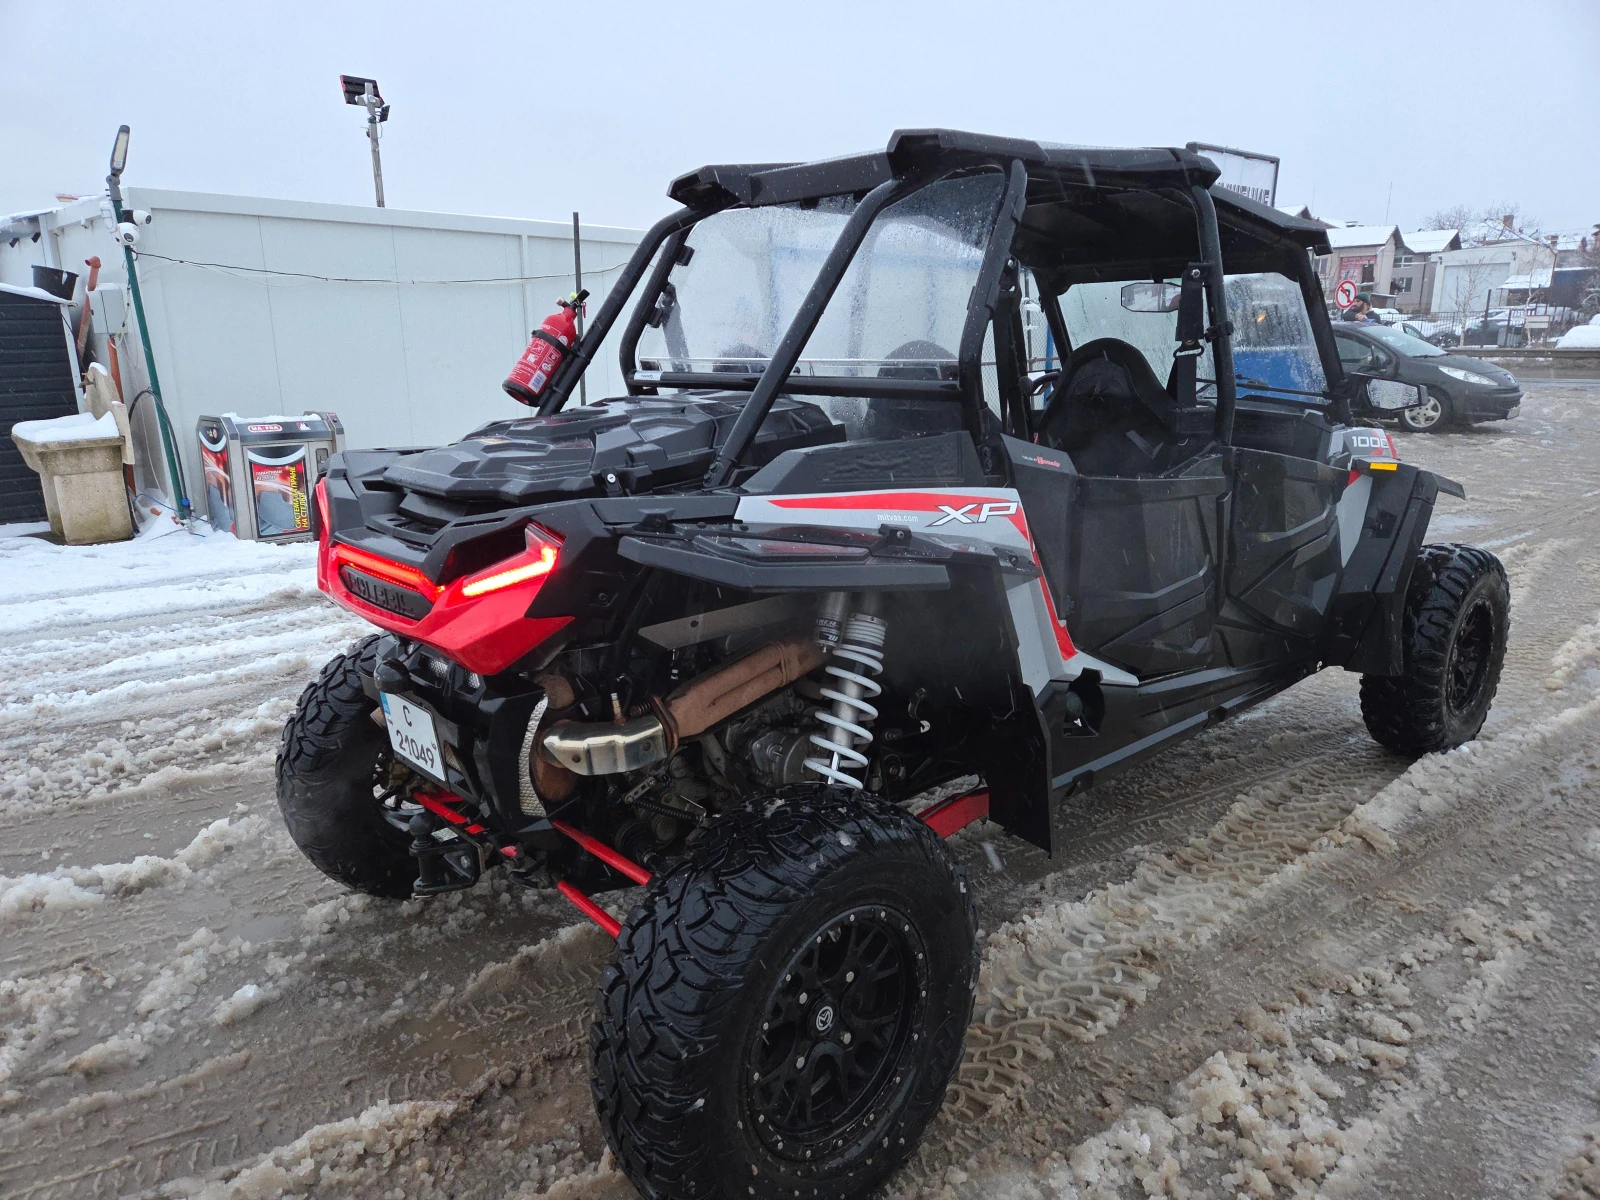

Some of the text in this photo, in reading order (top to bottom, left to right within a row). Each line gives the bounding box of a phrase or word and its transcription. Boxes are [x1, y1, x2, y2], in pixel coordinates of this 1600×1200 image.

[289, 466, 301, 529] СИСТЕМА ЗА ПРАНЕ
[302, 518, 309, 528] НА
[877, 512, 919, 523] mitvas.com
[926, 501, 1019, 527] XP
[402, 704, 413, 727] C
[396, 729, 435, 769] 21049
